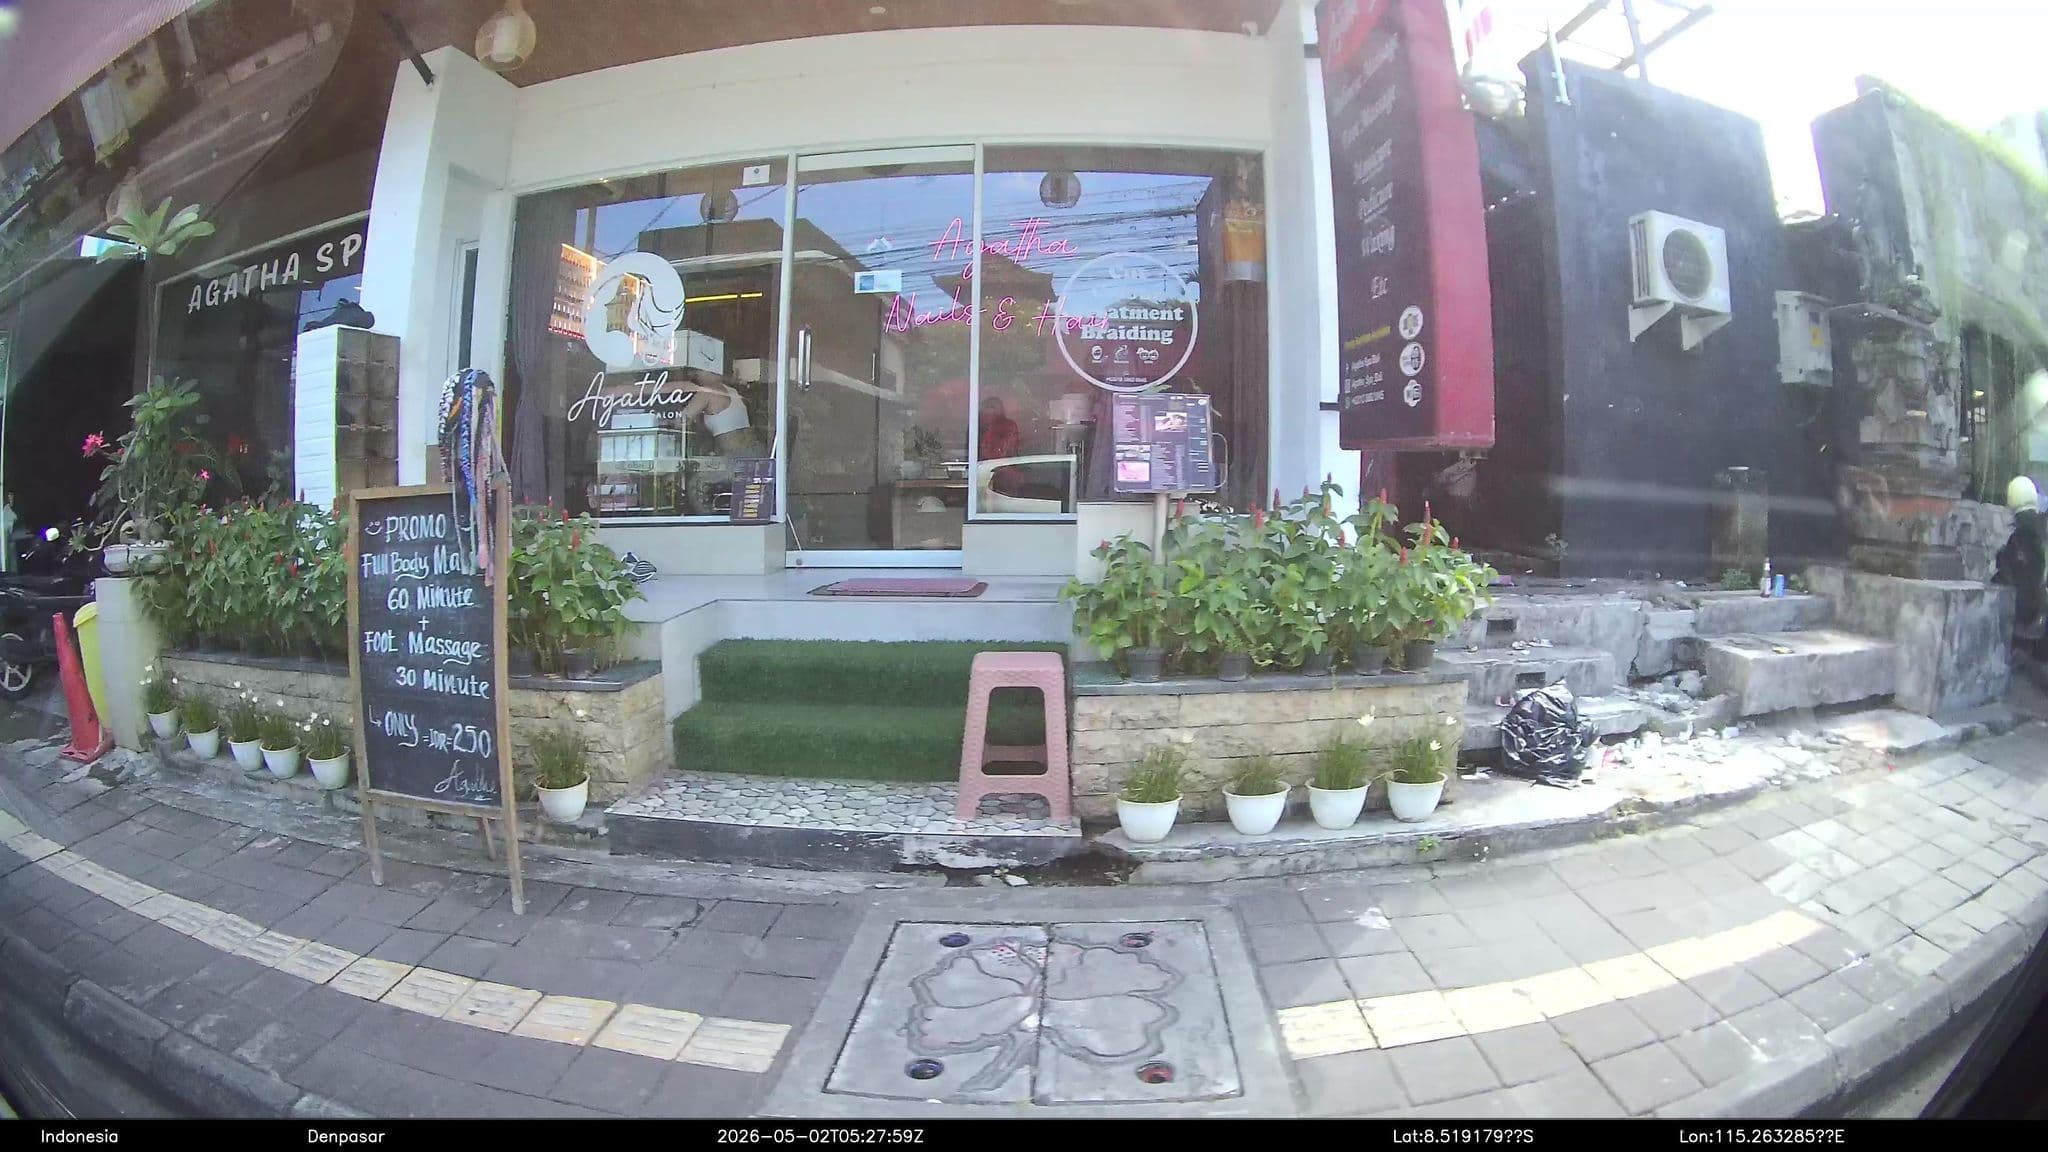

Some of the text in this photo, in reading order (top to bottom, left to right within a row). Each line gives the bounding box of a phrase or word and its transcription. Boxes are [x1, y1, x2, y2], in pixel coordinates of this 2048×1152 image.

[927, 217, 1078, 281] Agatha
[187, 252, 300, 315] AGATHA
[885, 285, 988, 334] Nails
[992, 297, 1017, 331] &
[1080, 325, 1174, 345] Braiding
[567, 371, 694, 428] Agatha
[385, 513, 447, 543] PROMO
[387, 587, 410, 612] 60
[395, 666, 416, 687] 30
